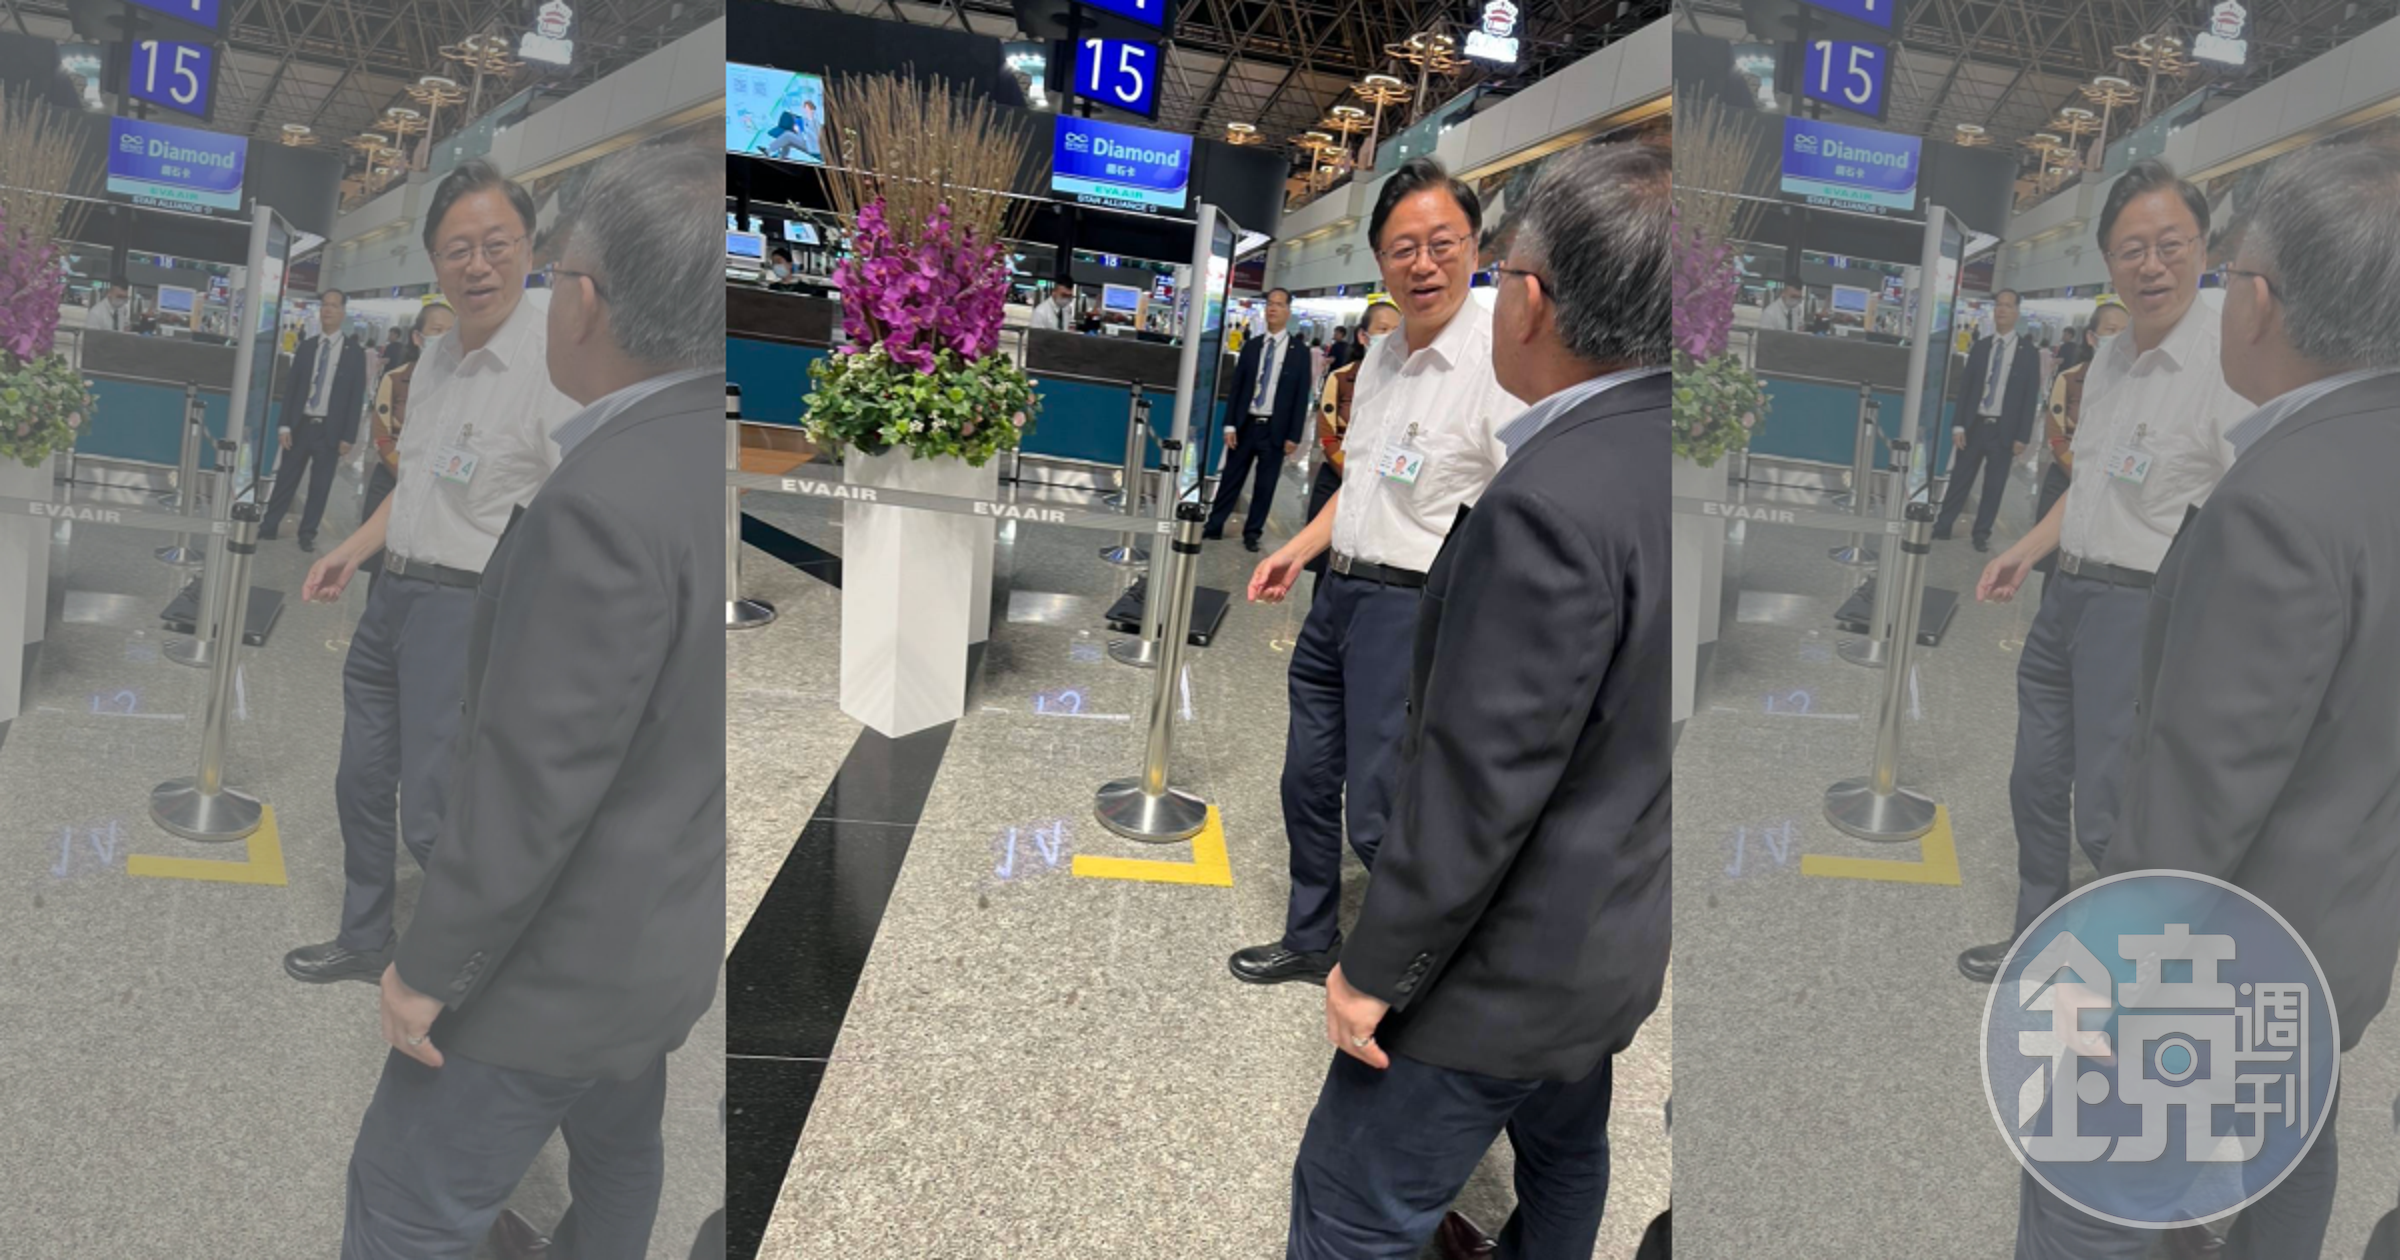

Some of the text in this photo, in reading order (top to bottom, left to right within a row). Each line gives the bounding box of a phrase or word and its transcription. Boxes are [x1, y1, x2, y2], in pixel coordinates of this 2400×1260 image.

[140, 39, 200, 104] 15
[1085, 38, 1145, 103] 15
[1814, 39, 1874, 104] 15
[148, 138, 236, 169] Diamond
[1093, 137, 1181, 168] Diamond
[1822, 138, 1910, 169] Diamond
[1077, 194, 1147, 212] STAR ALLIANCE
